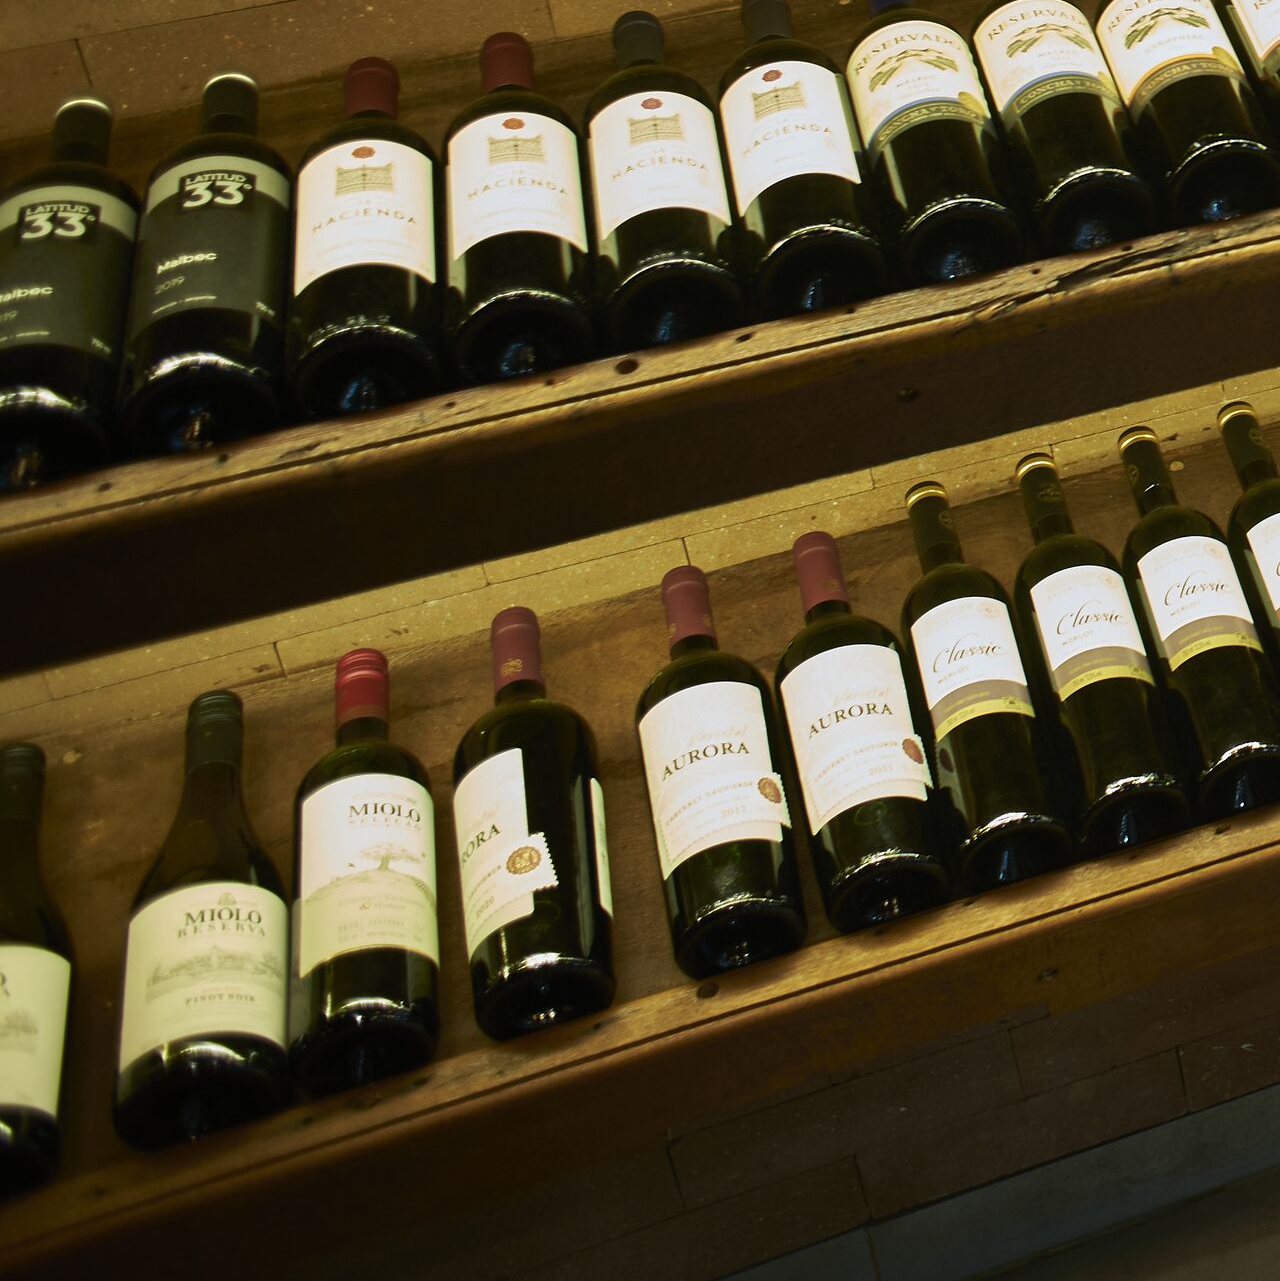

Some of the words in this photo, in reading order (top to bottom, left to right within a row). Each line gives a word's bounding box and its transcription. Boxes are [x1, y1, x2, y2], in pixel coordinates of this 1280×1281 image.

[467, 177, 570, 200] HACIENDA
[311, 206, 420, 235] HACIENDA
[156, 252, 220, 277] Malbec
[1164, 569, 1235, 607] Classic
[1056, 600, 1129, 636] Classic
[932, 633, 1008, 674] Classic
[807, 701, 896, 741] AURORA
[662, 741, 753, 782] AURORA
[347, 801, 423, 824] MIOLO
[177, 921, 267, 941] RESERVA
[184, 907, 263, 929] MIOLO
